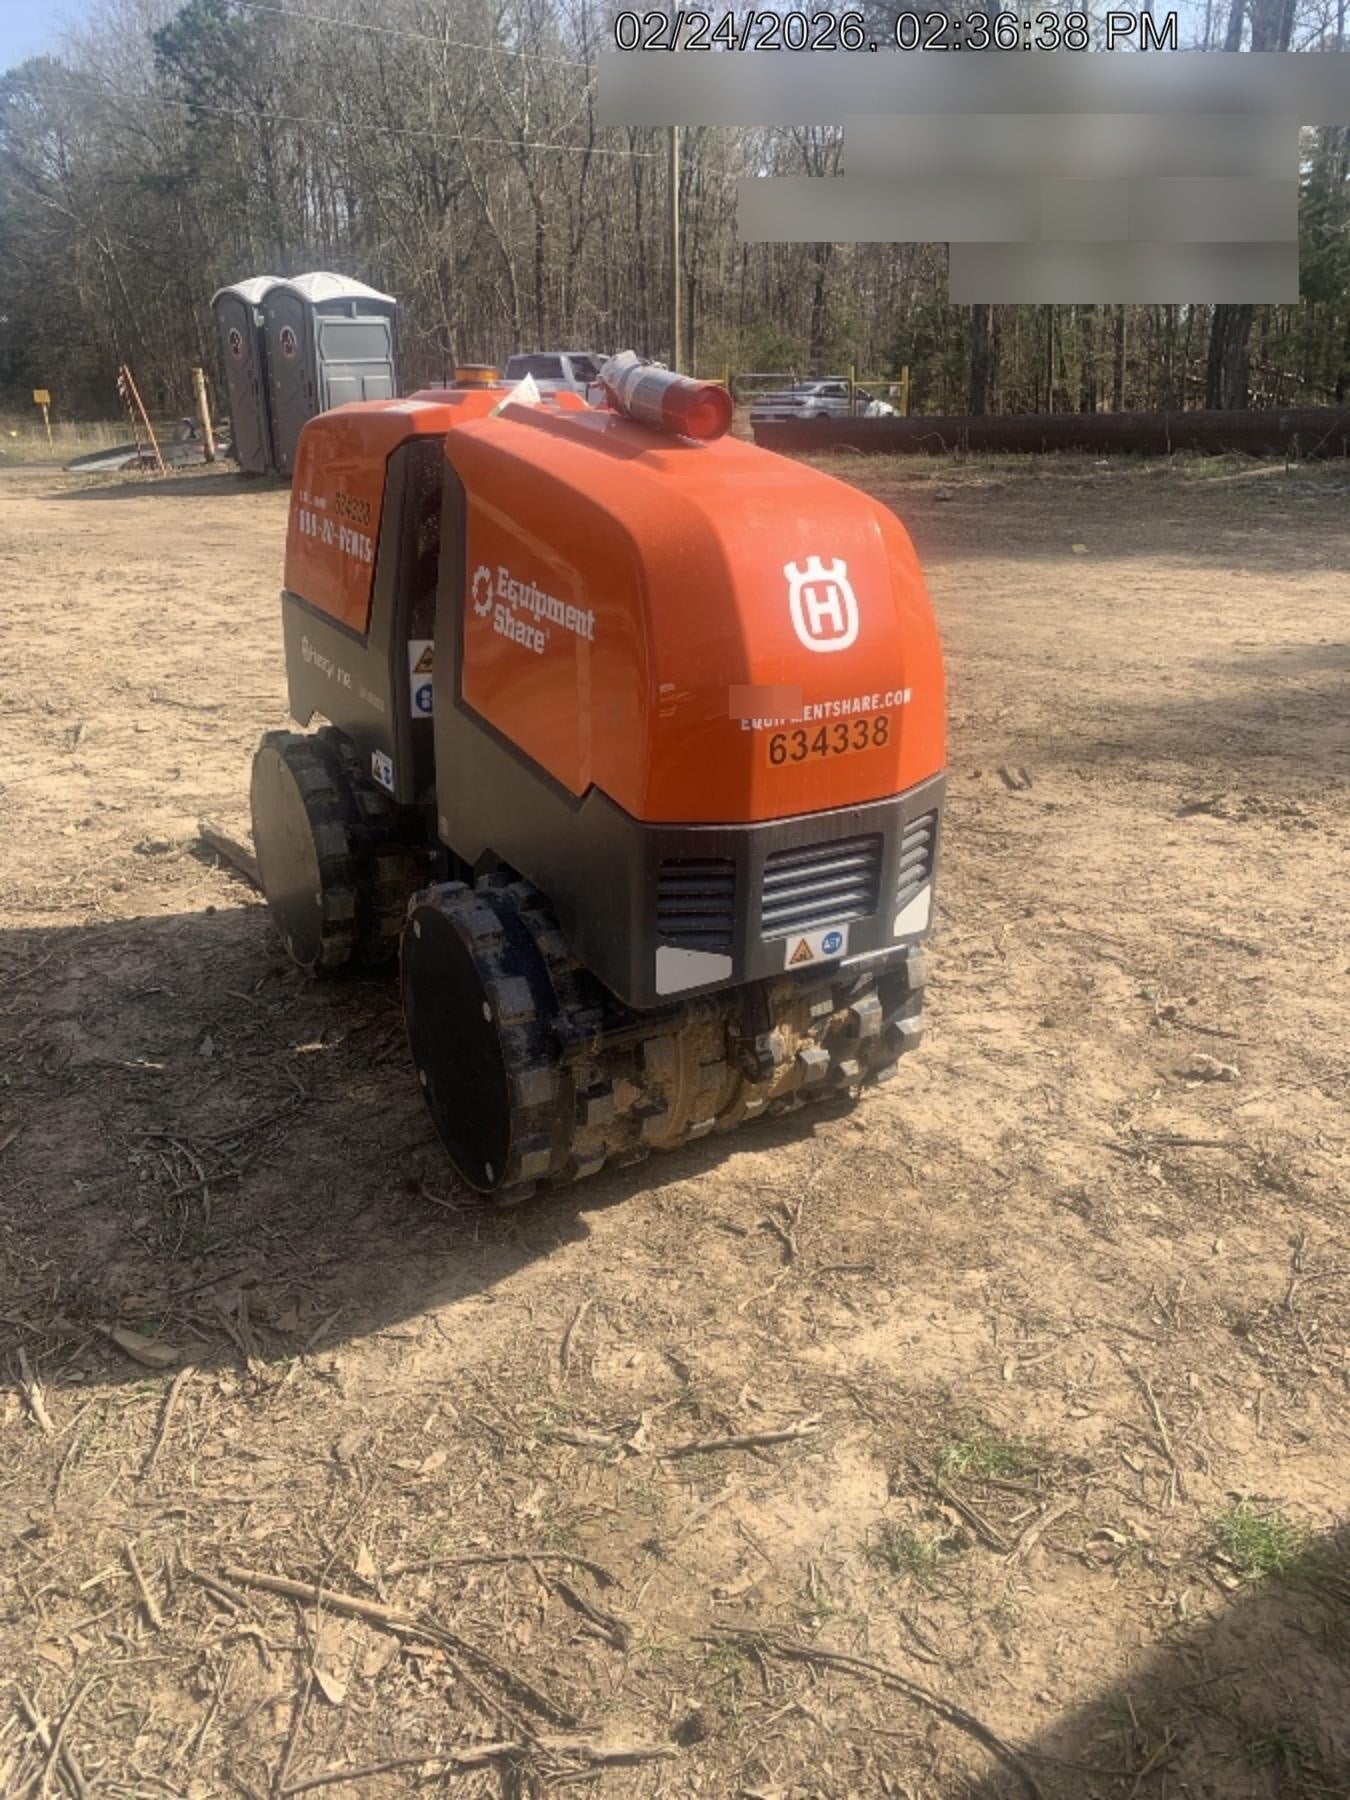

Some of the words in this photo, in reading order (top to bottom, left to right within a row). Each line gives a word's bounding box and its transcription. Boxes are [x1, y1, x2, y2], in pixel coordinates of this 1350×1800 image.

[493, 603, 546, 655] Share
[496, 566, 596, 641] Equipment
[768, 715, 889, 766] 634338
